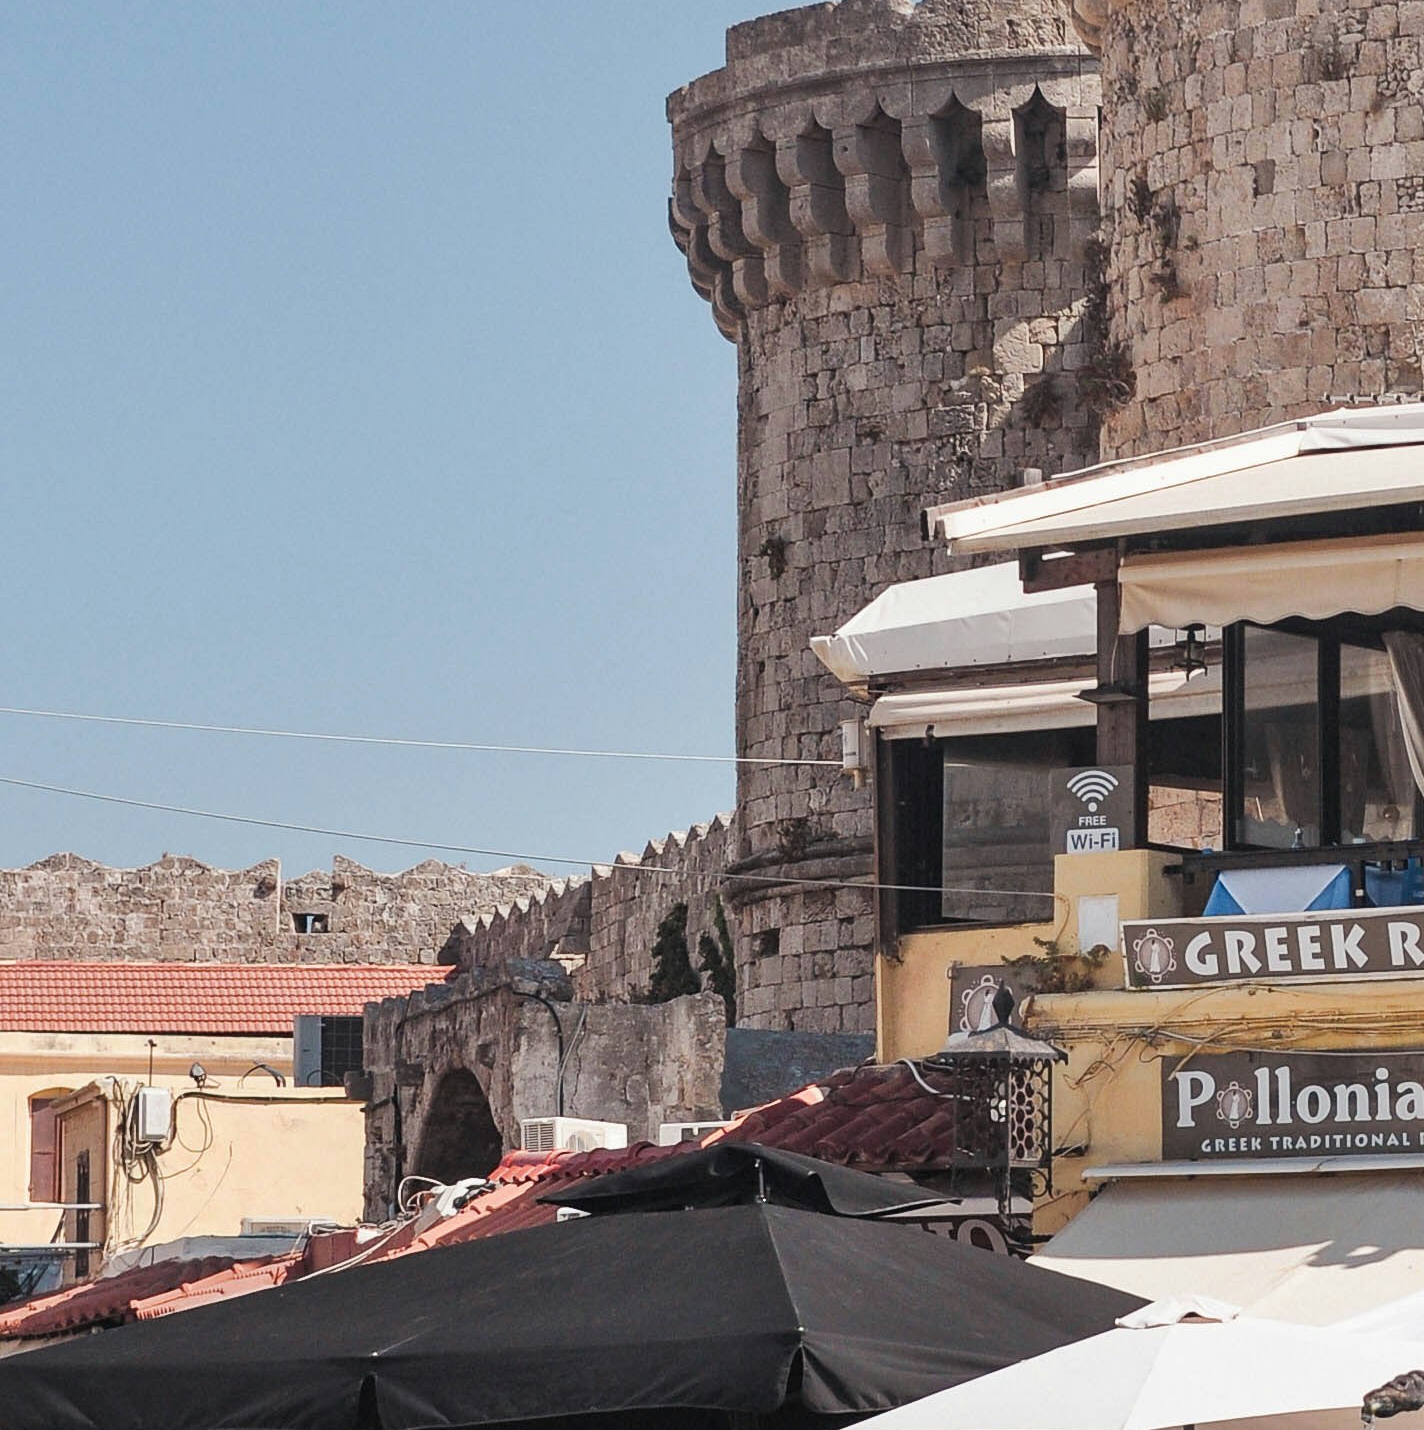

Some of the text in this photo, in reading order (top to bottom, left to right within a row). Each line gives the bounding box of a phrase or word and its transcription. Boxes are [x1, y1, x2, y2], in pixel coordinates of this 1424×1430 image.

[1078, 815, 1107, 827] FREE
[1070, 831, 1117, 851] Wi-Fi
[1184, 923, 1367, 977] GREEK
[1201, 1136, 1262, 1153] GREEK
[1269, 1132, 1411, 1150] TRADITIONAL
